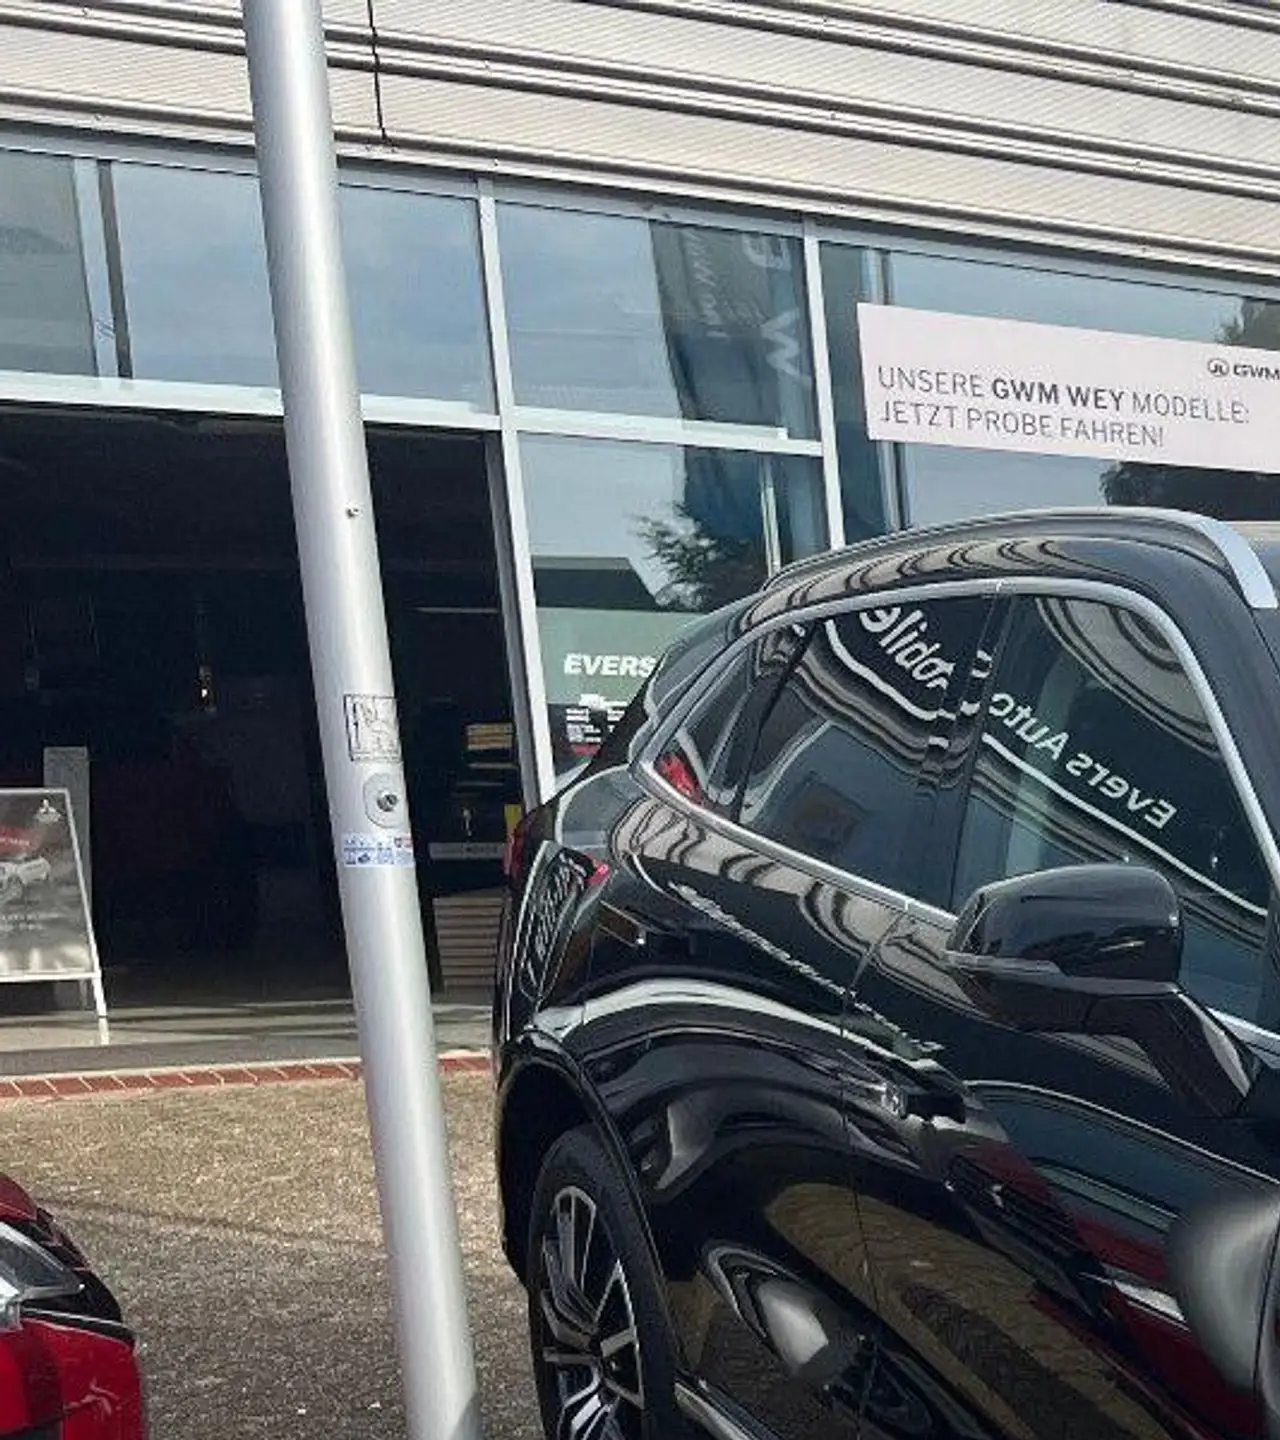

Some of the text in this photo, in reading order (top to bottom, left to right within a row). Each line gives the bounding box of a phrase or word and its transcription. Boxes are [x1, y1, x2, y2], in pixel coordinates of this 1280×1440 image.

[1233, 364, 1280, 381] GWM
[878, 365, 1250, 424] UNSERE GWM WEY MODELLE:
[879, 400, 1164, 448] JETZT PROBE FAHREN!
[563, 652, 657, 678] EVERS
